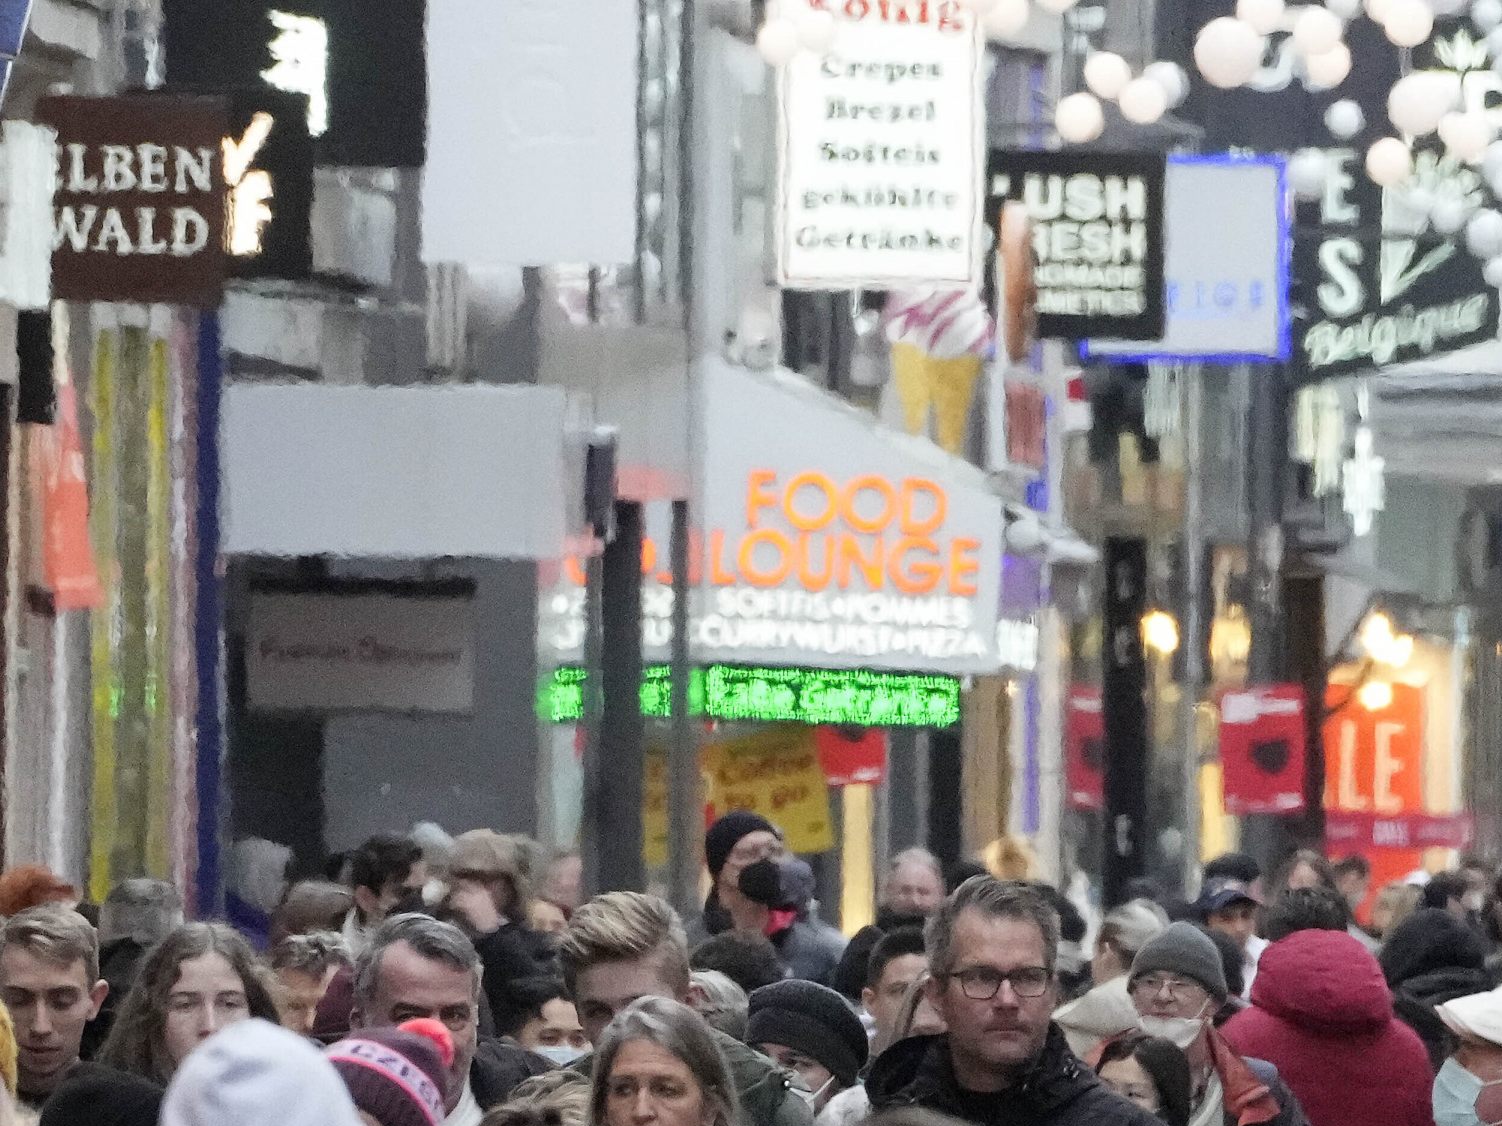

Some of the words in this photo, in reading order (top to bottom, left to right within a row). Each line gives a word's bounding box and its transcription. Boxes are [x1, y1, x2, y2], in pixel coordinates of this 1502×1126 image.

[51, 204, 210, 256] WALD
[746, 470, 948, 538] FOOD
[710, 529, 981, 597] LOUNGE
